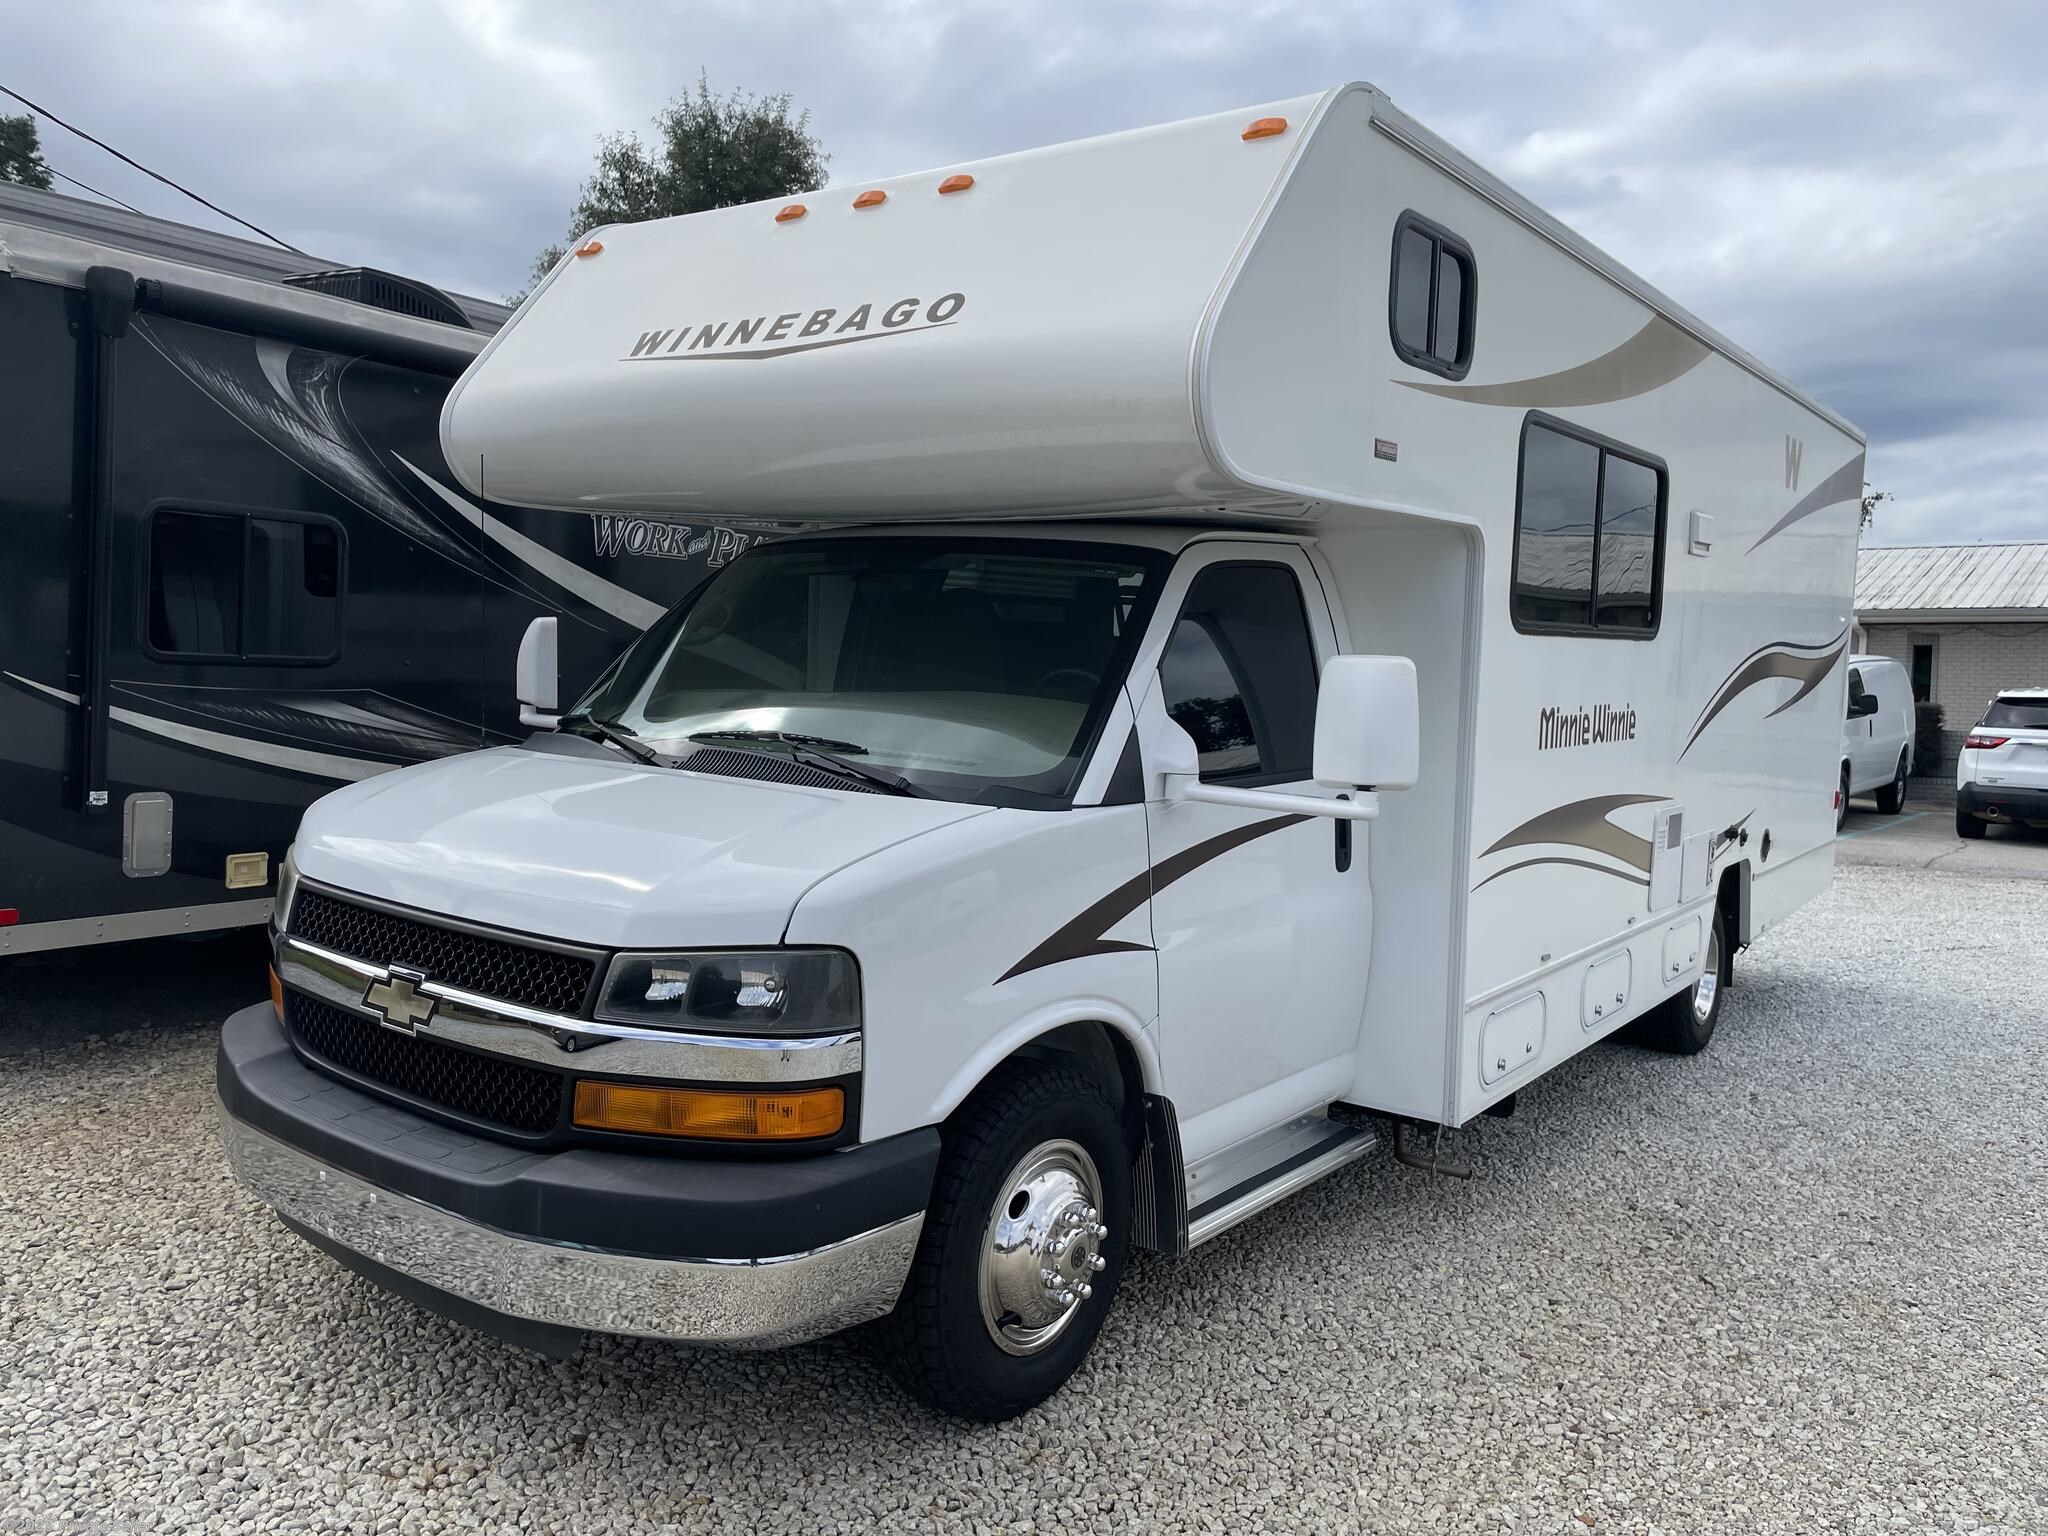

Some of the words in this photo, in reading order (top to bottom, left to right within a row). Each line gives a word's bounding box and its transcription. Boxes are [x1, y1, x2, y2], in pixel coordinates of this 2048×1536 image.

[629, 292, 966, 357] WINNEBAGO
[1785, 433, 1803, 492] W
[591, 513, 691, 560] WORK
[688, 530, 711, 555] and
[1538, 705, 1591, 750] Minnie
[1592, 703, 1636, 744] Winnie
